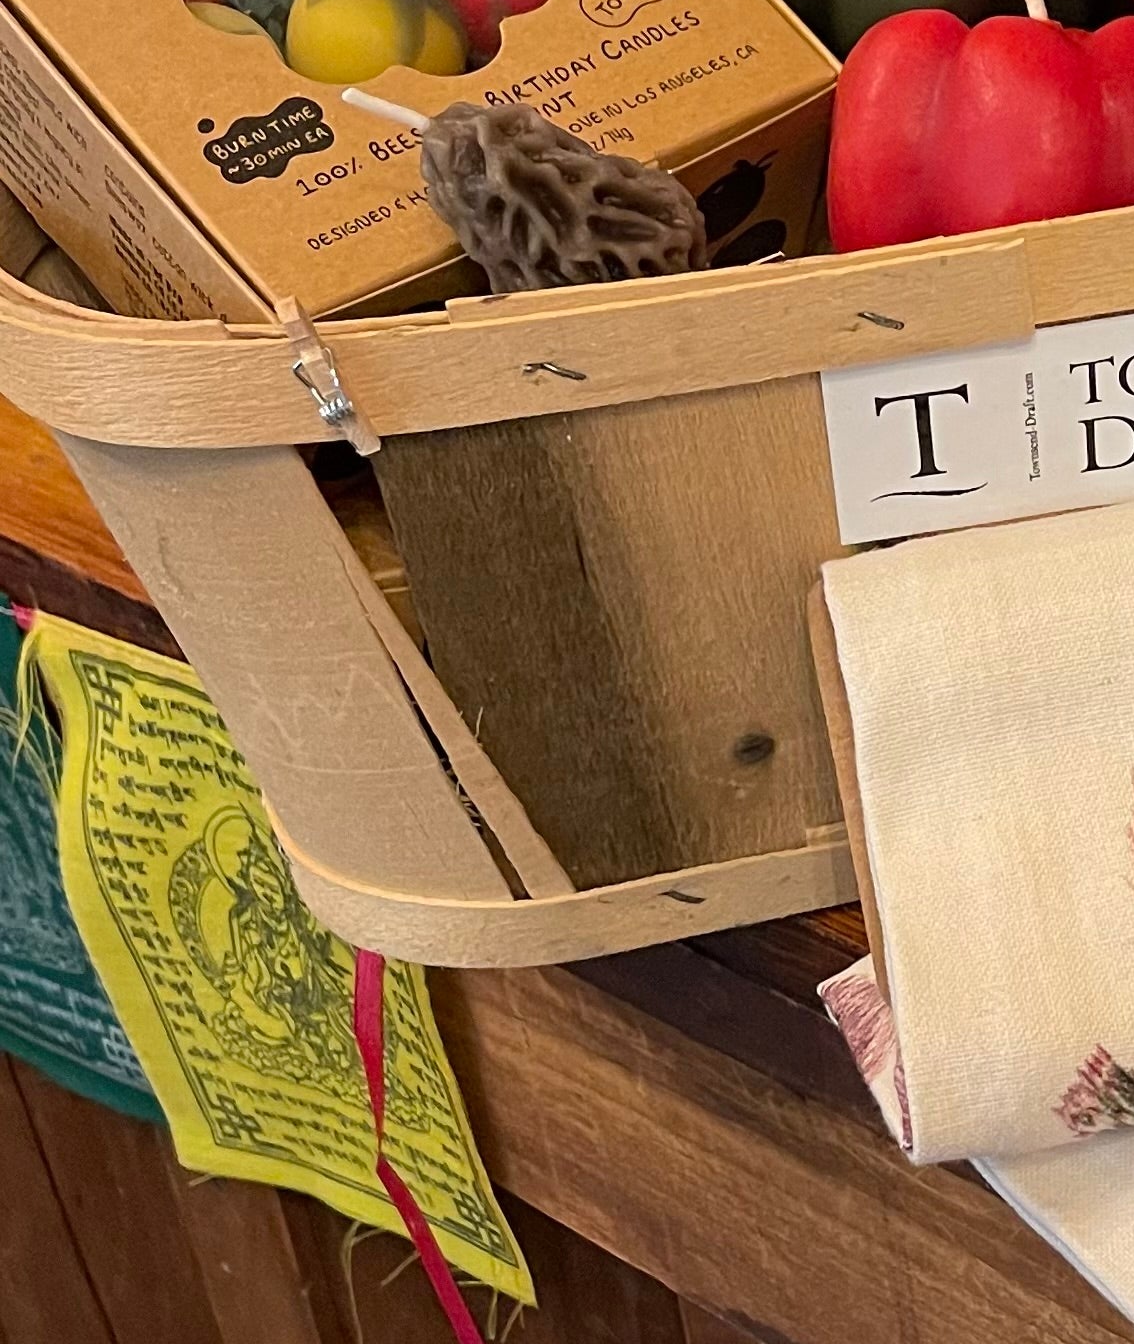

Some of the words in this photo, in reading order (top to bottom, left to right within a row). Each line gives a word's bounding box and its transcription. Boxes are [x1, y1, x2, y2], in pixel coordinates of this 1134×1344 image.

[212, 128, 267, 160] BURN
[266, 105, 315, 133] TIME
[295, 156, 364, 197] 100%
[368, 127, 424, 161] BEES
[484, 53, 598, 106] BIRTHDAY
[304, 127, 330, 143] EA
[306, 205, 392, 251] DESIGNED
[568, 111, 604, 134] OVE
[601, 102, 623, 118] IN
[621, 86, 658, 108] LOS
[735, 43, 760, 60] CA
[874, 383, 970, 480] T
